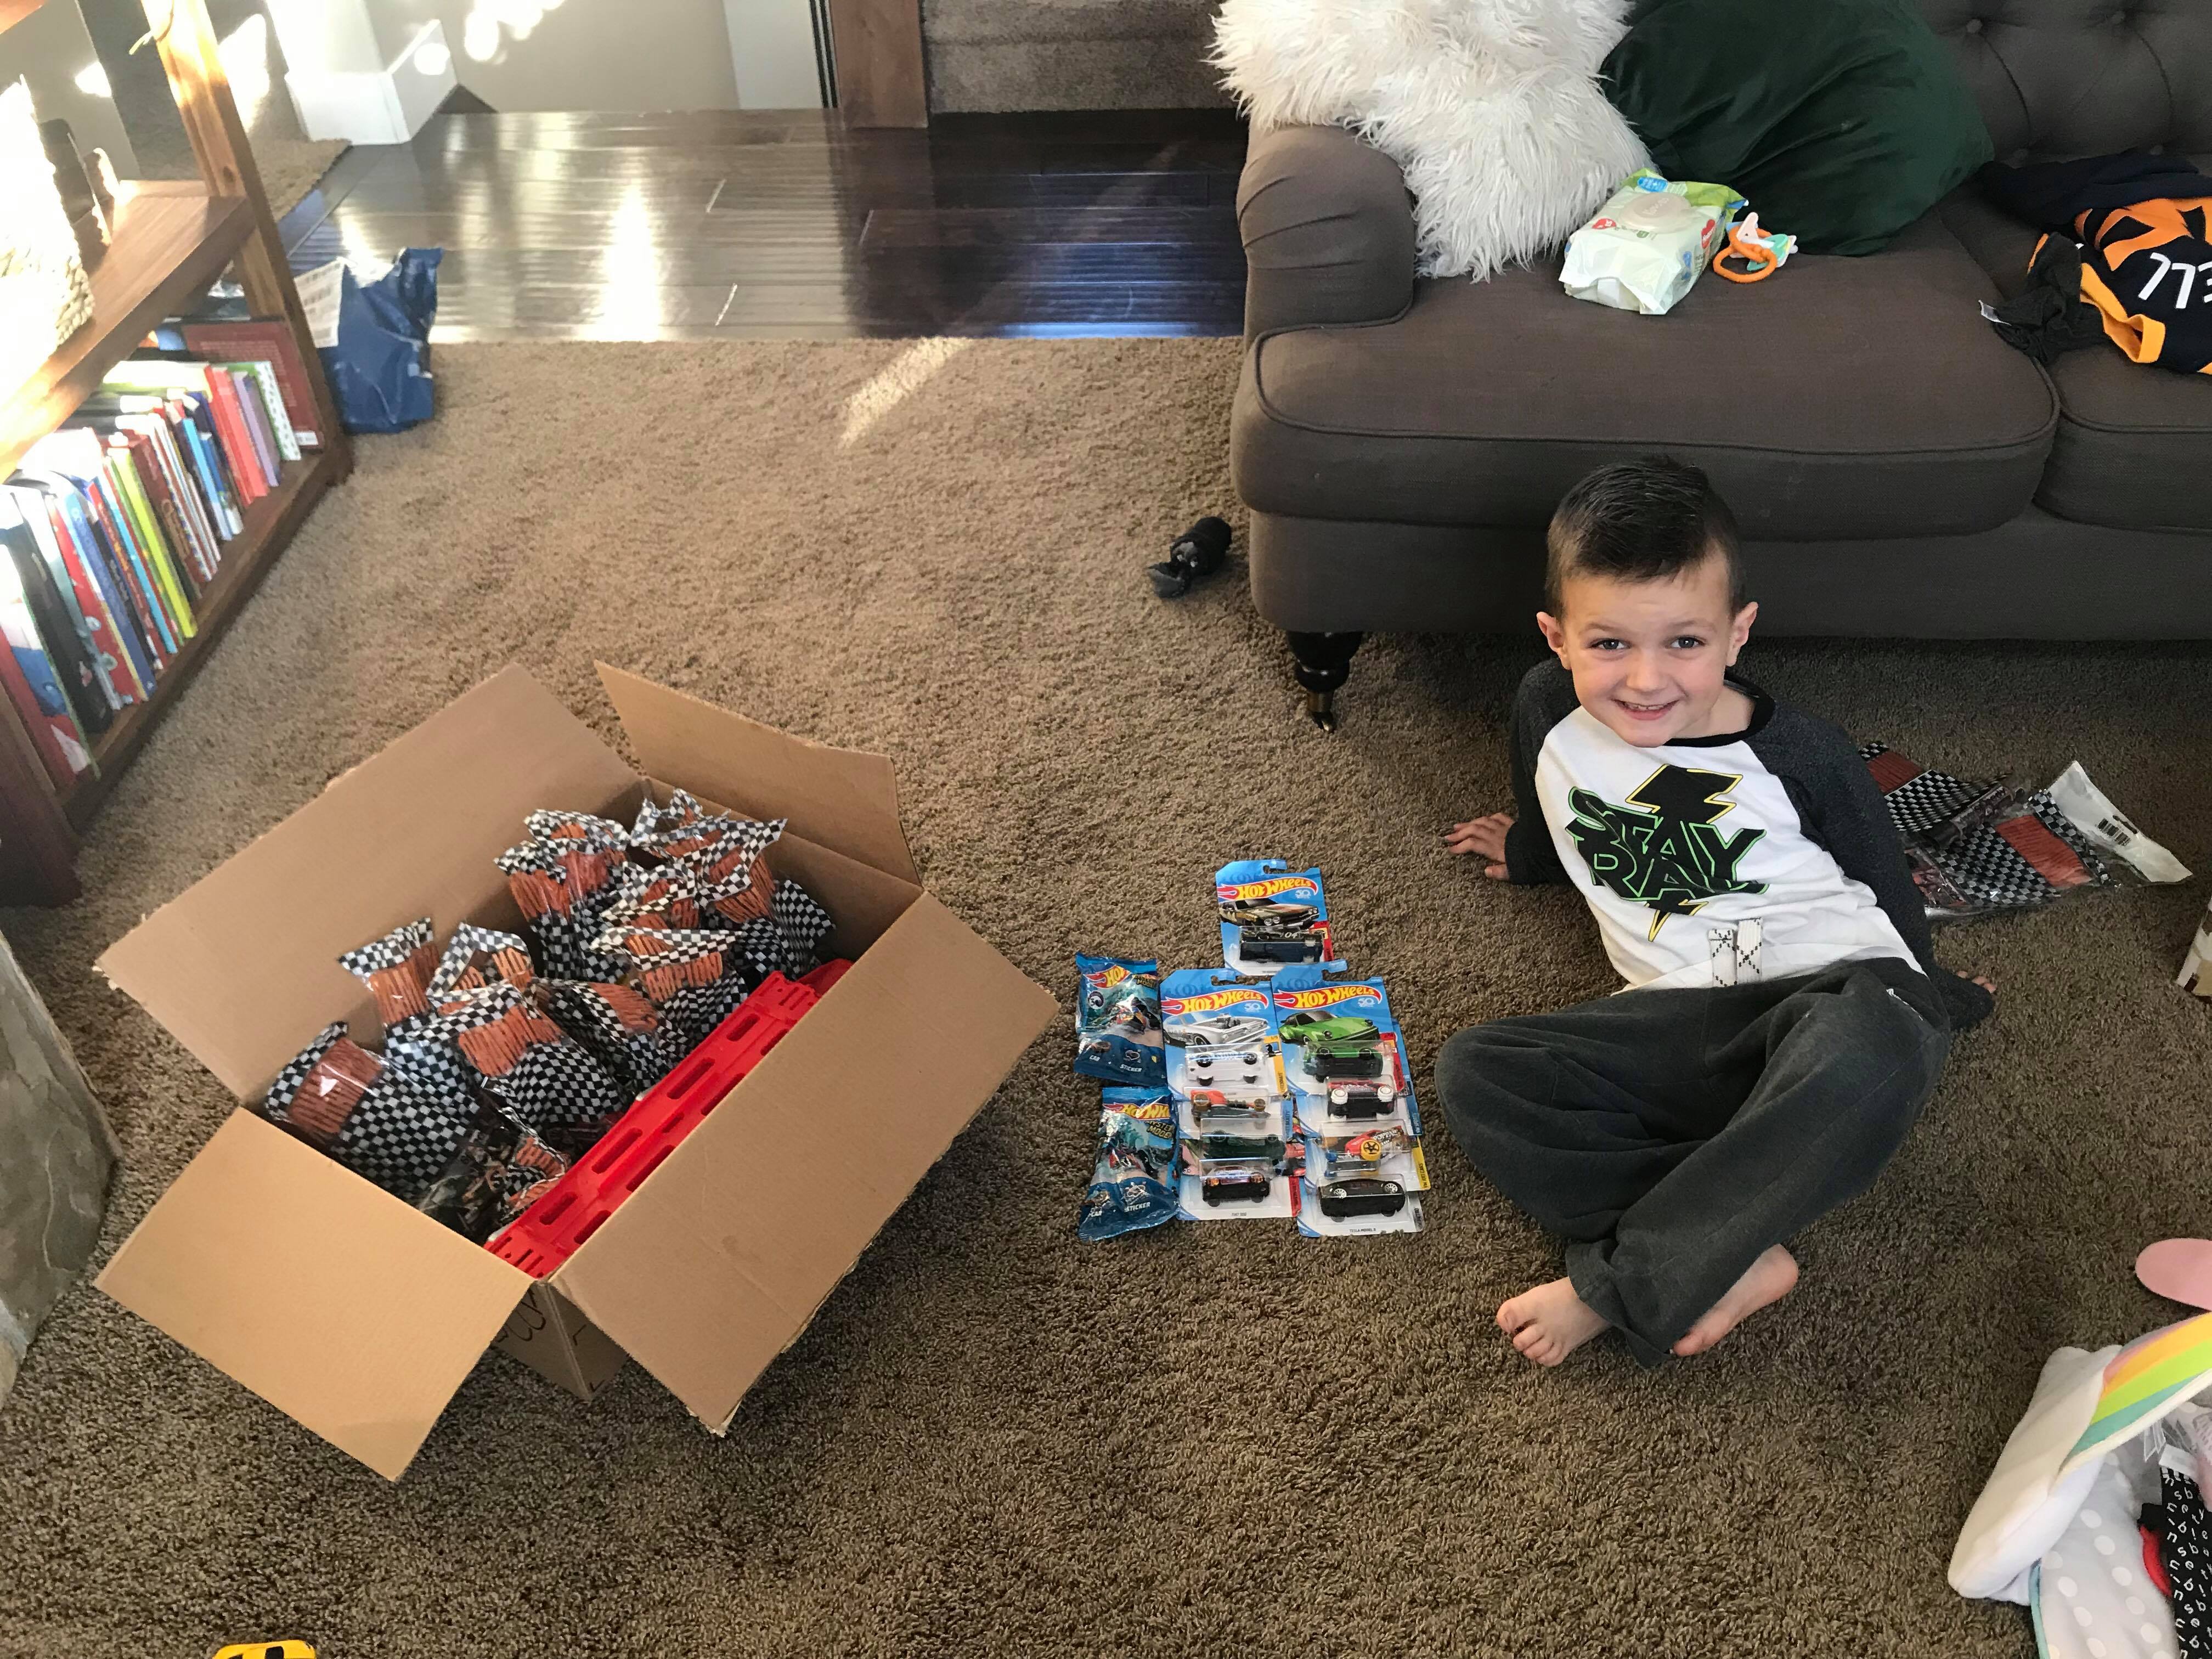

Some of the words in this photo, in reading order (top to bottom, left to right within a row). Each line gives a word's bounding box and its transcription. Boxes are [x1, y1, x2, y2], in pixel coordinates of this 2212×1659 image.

[1568, 786, 1768, 883] STAY
[1235, 882, 1268, 900] HOT
[639, 951, 723, 1003] AMPION
[1182, 996, 1213, 1013] HOT
[1294, 992, 1327, 1008] HOT
[1120, 1064, 1142, 1073] STICKER
[1124, 1201, 1150, 1212] STICKER
